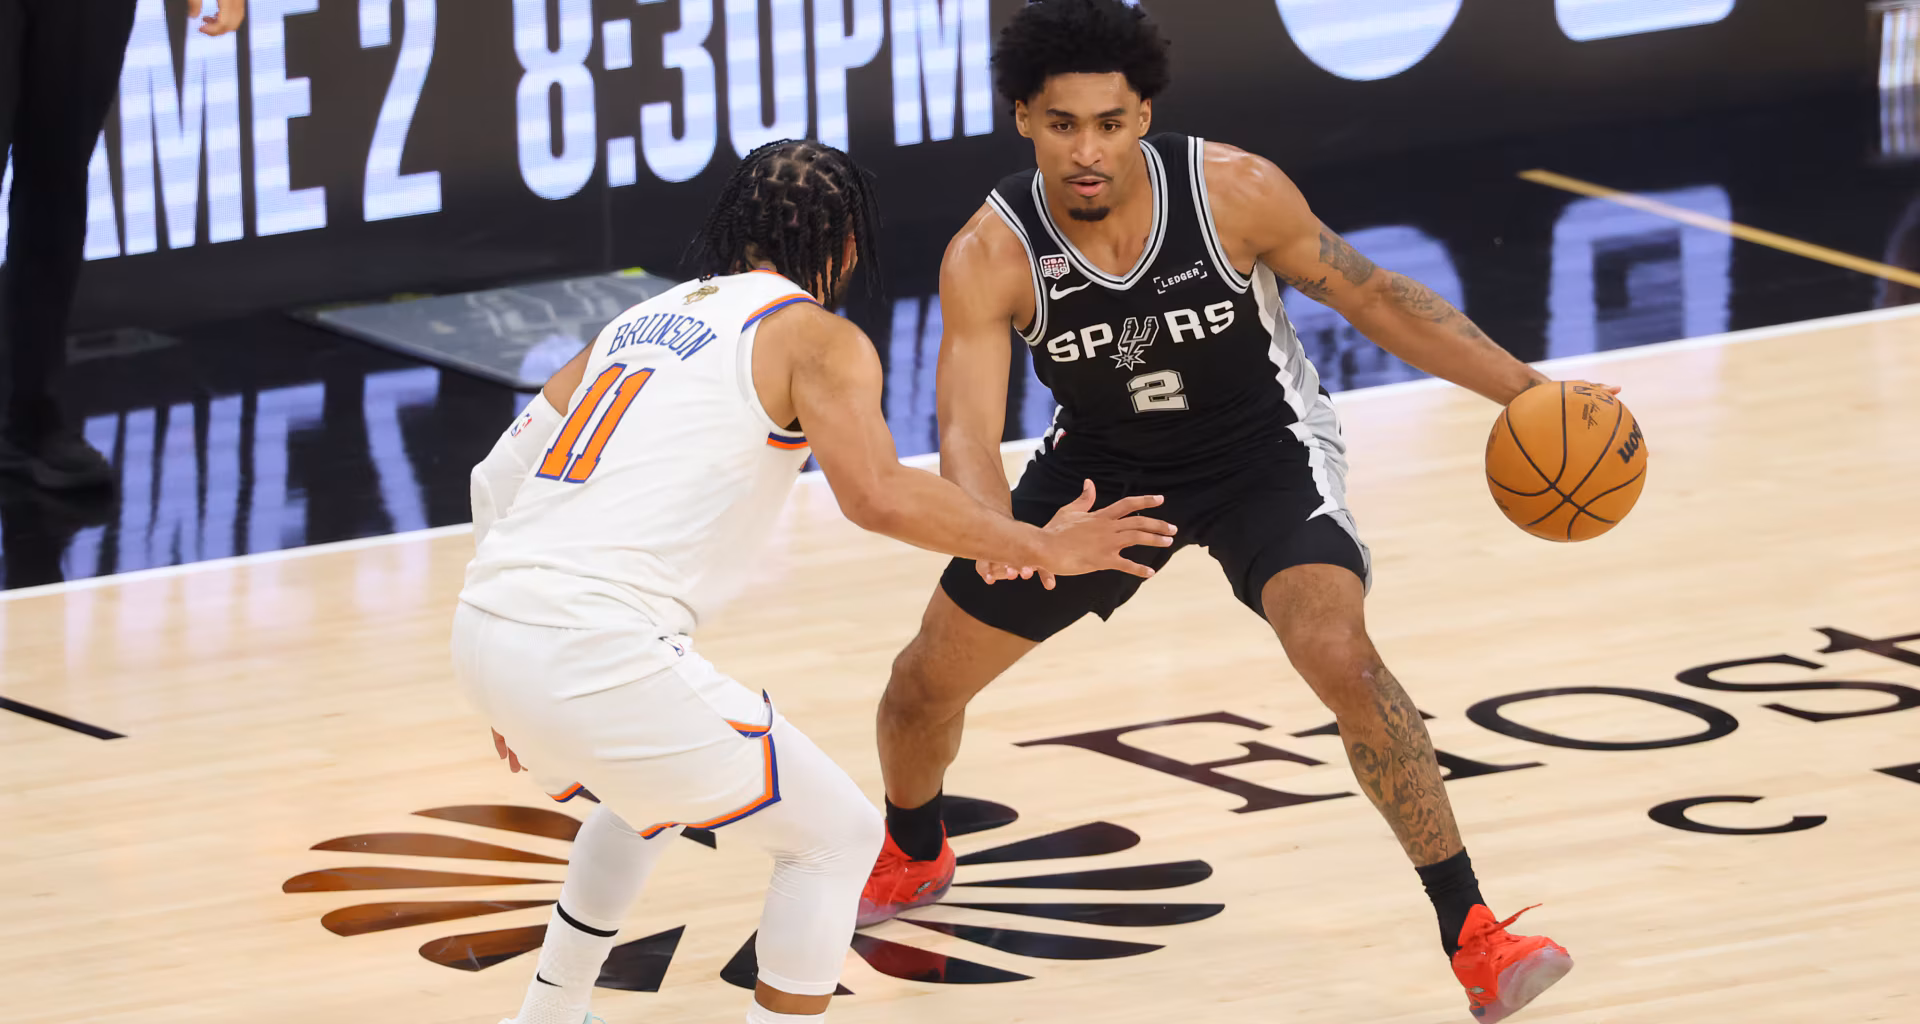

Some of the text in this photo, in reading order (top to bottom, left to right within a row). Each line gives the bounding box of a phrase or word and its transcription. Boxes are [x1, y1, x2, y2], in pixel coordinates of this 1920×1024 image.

[0, 0, 994, 265] ME 2 8:30PM
[1161, 267, 1200, 288] LEDGER
[607, 313, 718, 361] BRUNSON
[1047, 300, 1235, 371] SPURS
[1126, 369, 1189, 414] 2
[535, 363, 656, 483] 11
